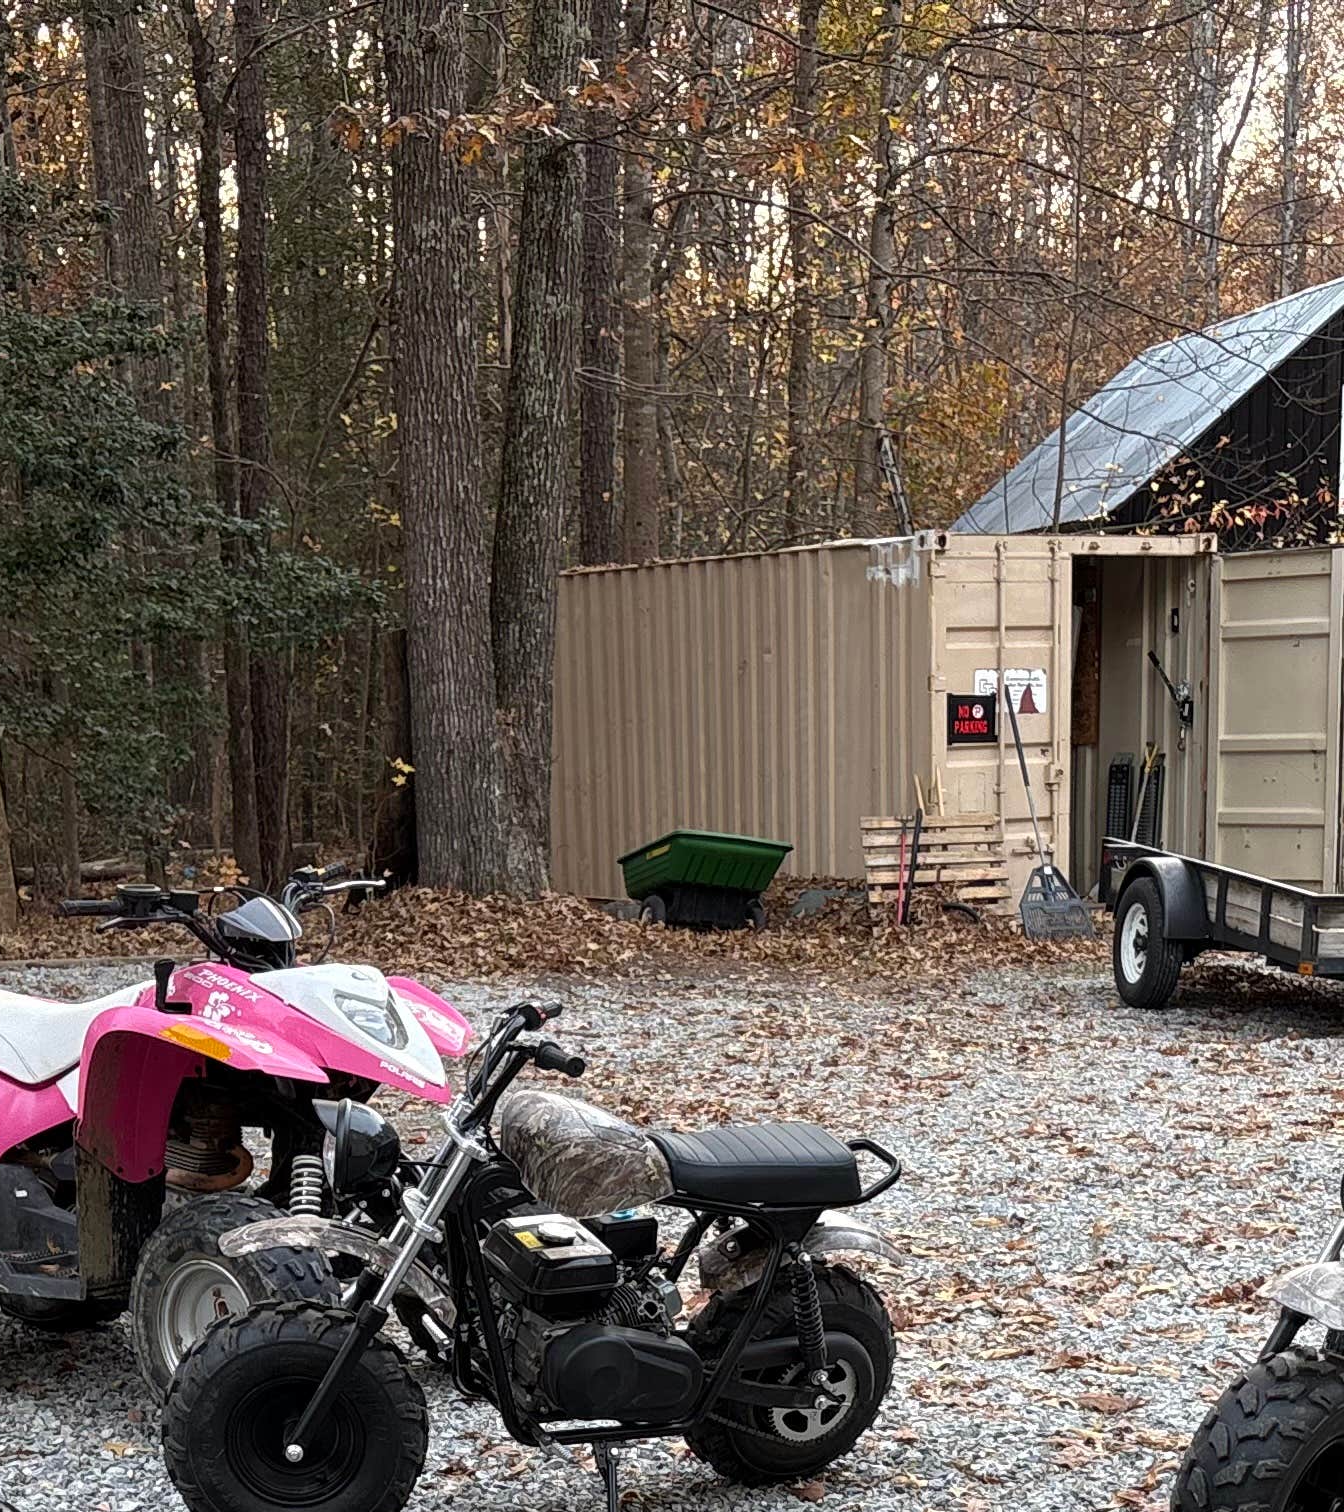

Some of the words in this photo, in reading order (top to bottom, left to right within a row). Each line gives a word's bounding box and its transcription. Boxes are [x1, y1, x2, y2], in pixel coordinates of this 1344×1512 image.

[958, 705, 970, 718] NO
[954, 720, 988, 734] PARKING
[197, 968, 264, 1003] PHOENIX
[379, 1060, 426, 1089] POLARIS
